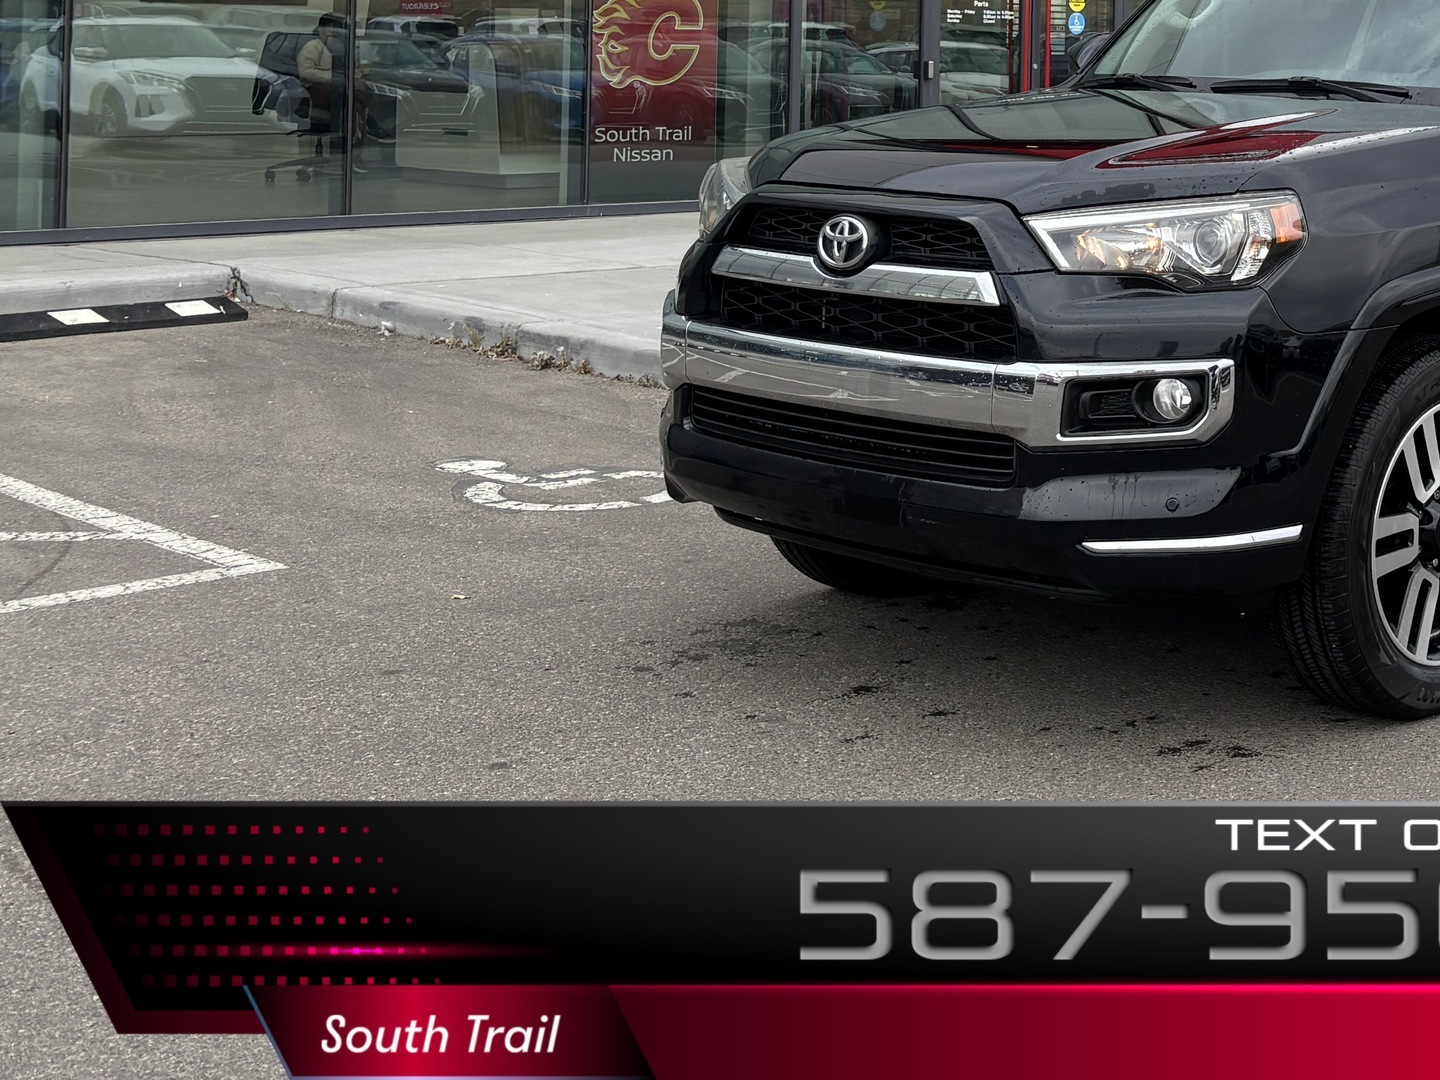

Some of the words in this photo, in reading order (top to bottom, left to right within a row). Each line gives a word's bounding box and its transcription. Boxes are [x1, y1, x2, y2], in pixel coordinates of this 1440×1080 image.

[594, 126, 650, 142] South
[655, 126, 692, 141] Trail
[613, 147, 674, 162] Nissan
